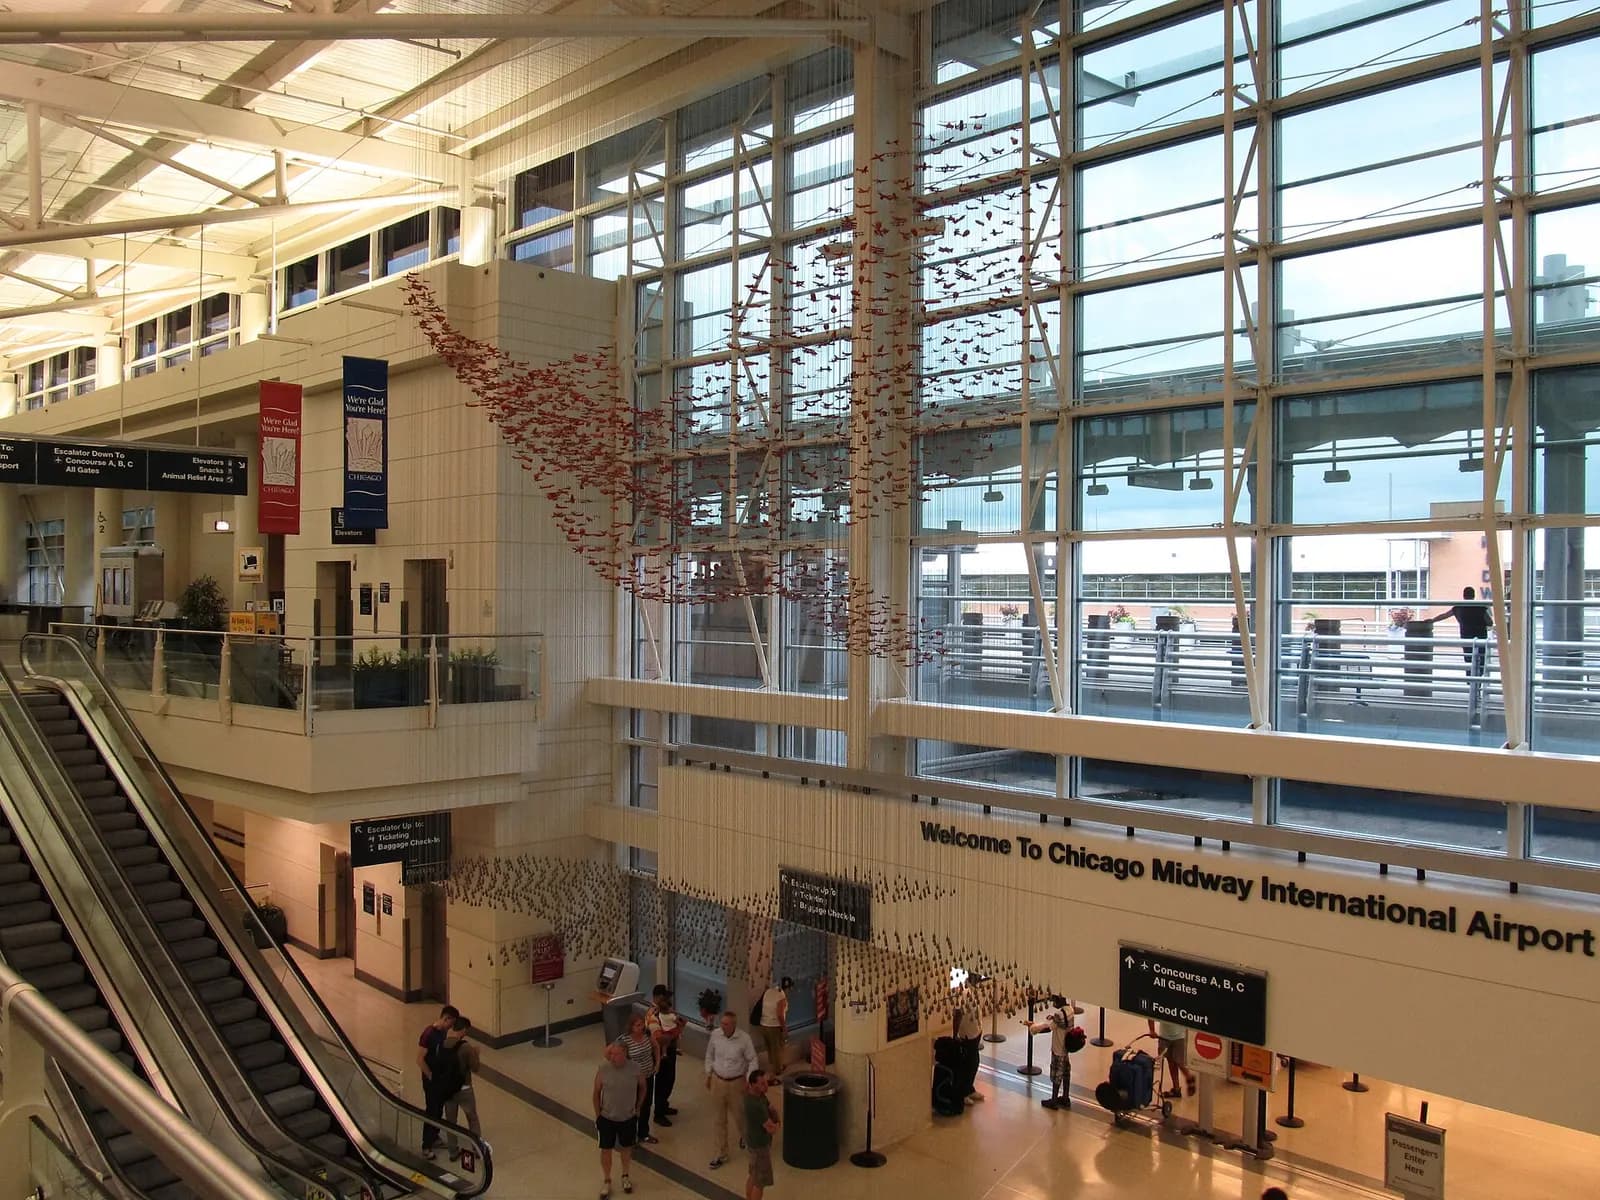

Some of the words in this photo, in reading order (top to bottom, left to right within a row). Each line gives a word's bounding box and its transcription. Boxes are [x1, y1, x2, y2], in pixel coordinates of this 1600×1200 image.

[347, 395, 366, 404] We're
[368, 397, 384, 405] Glad
[346, 404, 365, 413] You're
[368, 406, 385, 415] Here!
[282, 425, 299, 434] Here!
[54, 448, 90, 456] Escalator
[66, 457, 106, 466] Concourse
[193, 457, 224, 466] Elevators
[368, 824, 400, 833] Escalator
[378, 832, 409, 841] Ticketing
[378, 842, 408, 851] Baggage
[920, 821, 1011, 854] Welcome
[1016, 836, 1042, 860] To
[1049, 842, 1144, 880] Chicago
[1152, 858, 1254, 901] Midway
[1262, 876, 1456, 933] International
[1466, 910, 1595, 956] Airport
[1153, 963, 1207, 984] Concourse
[1210, 976, 1221, 988] A,
[1224, 980, 1234, 991] B,
[1236, 983, 1245, 992] C
[1153, 977, 1166, 988] All
[1168, 981, 1197, 995] Gates
[1153, 1002, 1177, 1017] Food
[1180, 1009, 1208, 1025] Court
[1392, 1138, 1438, 1159] Passengers
[1404, 1152, 1426, 1165] Enter
[1404, 1163, 1424, 1176] Here
